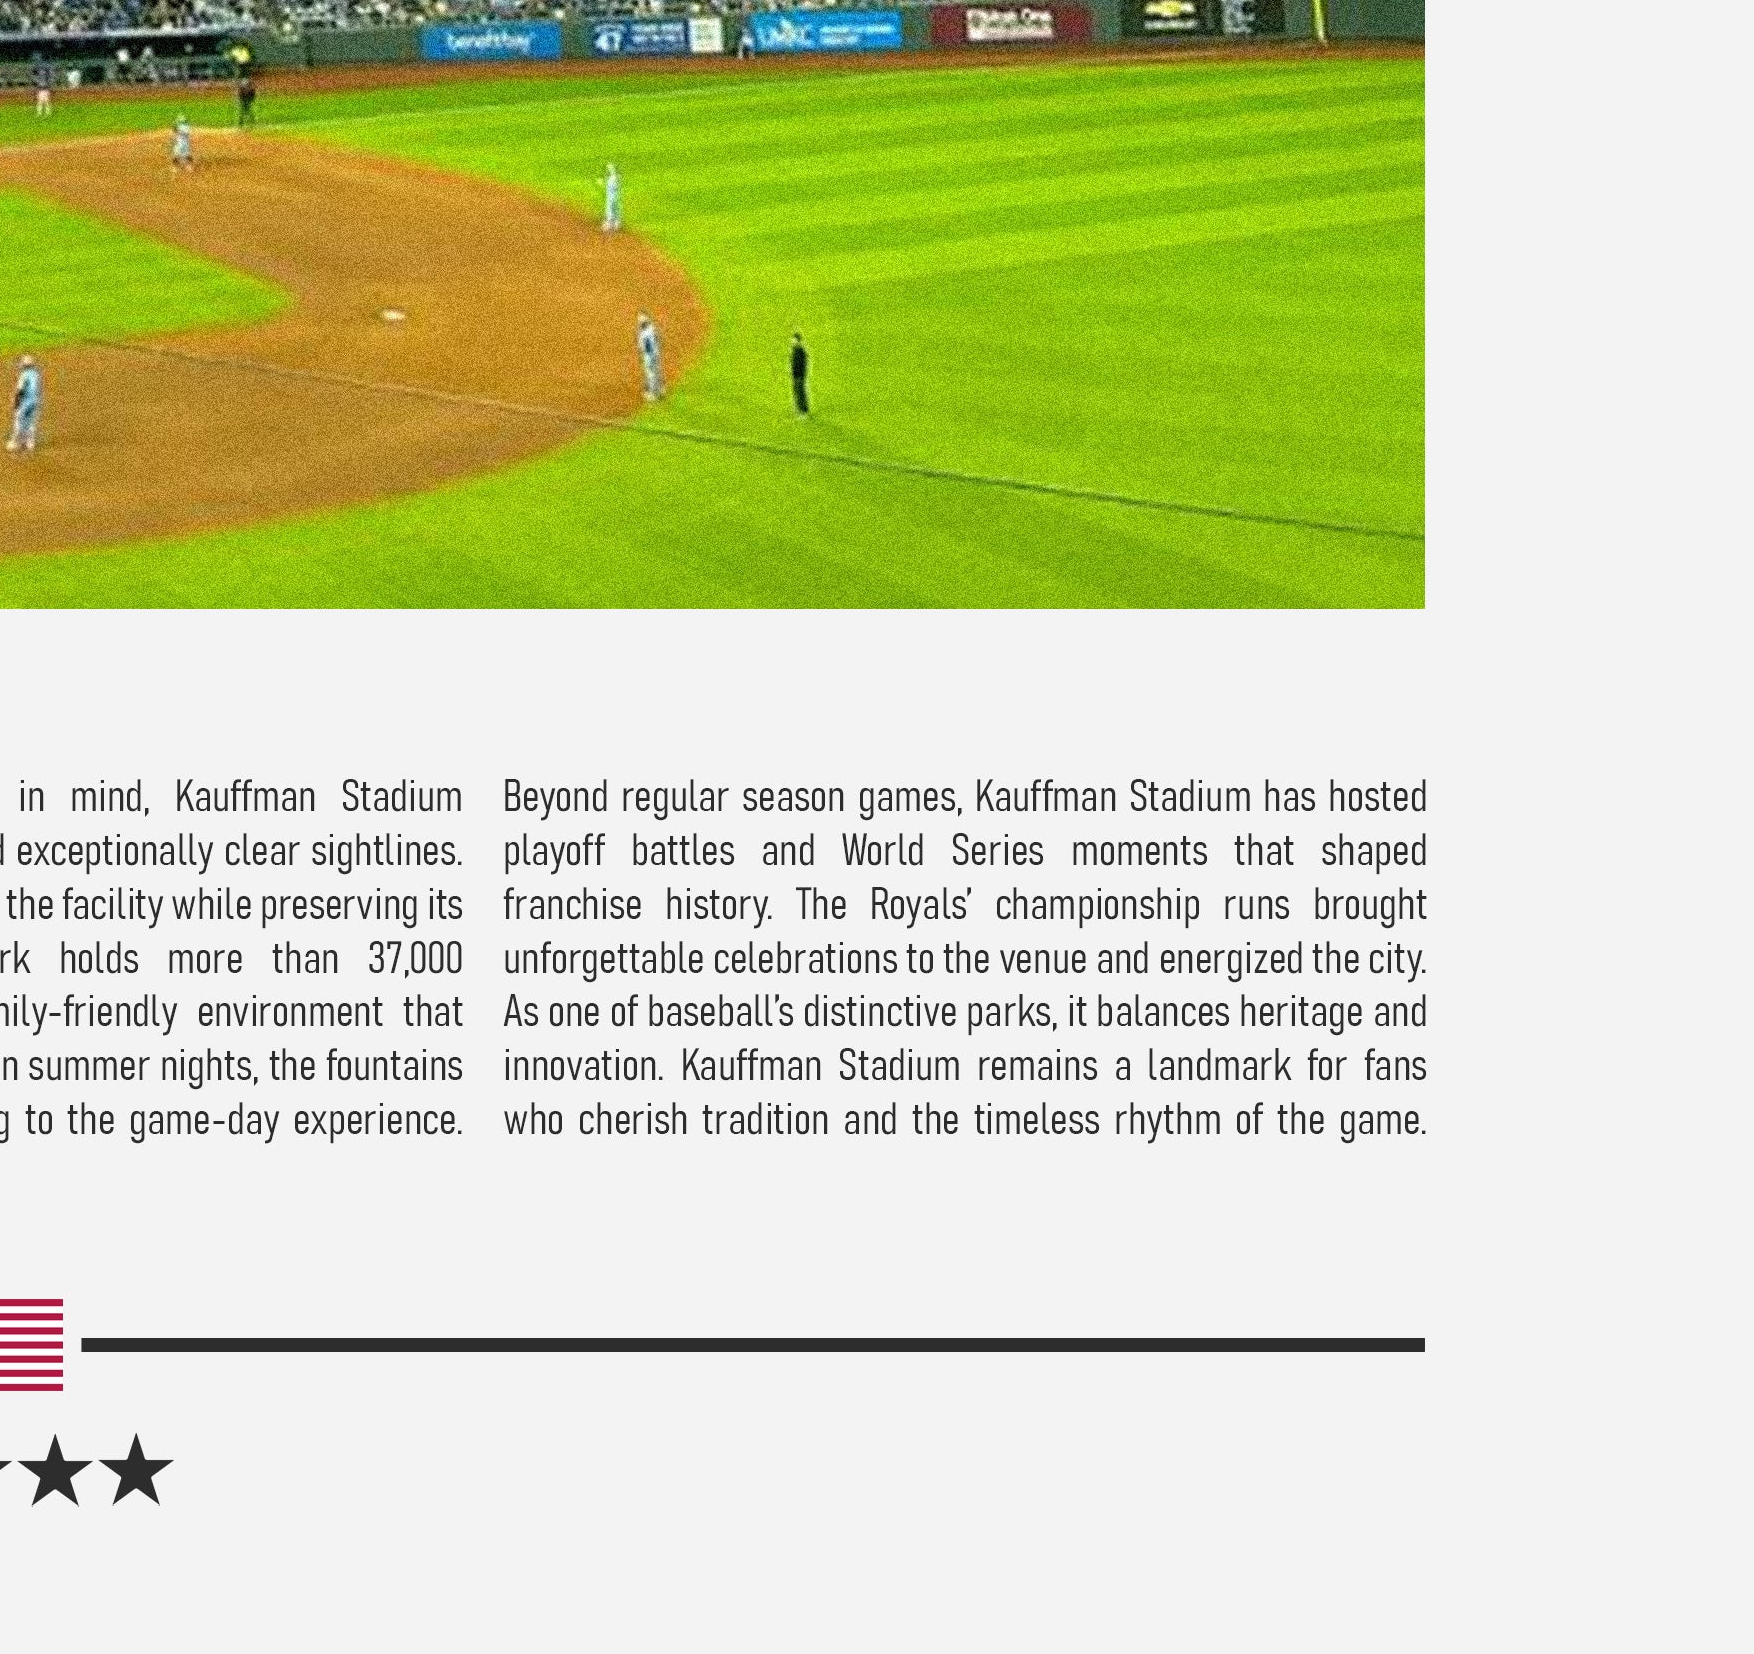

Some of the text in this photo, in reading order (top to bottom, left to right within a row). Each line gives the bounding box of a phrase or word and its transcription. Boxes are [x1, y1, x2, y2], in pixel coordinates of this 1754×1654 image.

[20, 779, 44, 812] in
[71, 778, 150, 818] mind,
[176, 778, 315, 812] Kauffman
[342, 778, 462, 812] Stadium
[504, 778, 1427, 822] Beyond regular season games, Kauffman Stadium has hosted
[17, 832, 214, 876] exceptionally
[225, 832, 301, 866] clear
[311, 832, 463, 875] sightlines.
[504, 832, 1427, 876] playoff battles and World Series moments that shaped
[60, 940, 139, 974] holds
[168, 949, 243, 974] more
[271, 940, 338, 974] than
[368, 940, 462, 980] 37,000
[504, 940, 1427, 984] unforgettable celebrations to the venue and energized the city.
[503, 993, 1427, 1036] As one of baseball’s distinctive parks, it balances heritage and
[28, 1056, 151, 1081] summer
[161, 1047, 259, 1090] nights,
[269, 1047, 316, 1081] the
[326, 1047, 463, 1081] fountains
[505, 1047, 1427, 1081] innovation. Kauffman Stadium remains a landmark for fans
[25, 1104, 53, 1135] to
[66, 1101, 115, 1135] the
[130, 1101, 280, 1144] game-day
[294, 1102, 463, 1144] experience.
[503, 1101, 1427, 1145] who cherish tradition and the timeless rhythm of the game.
